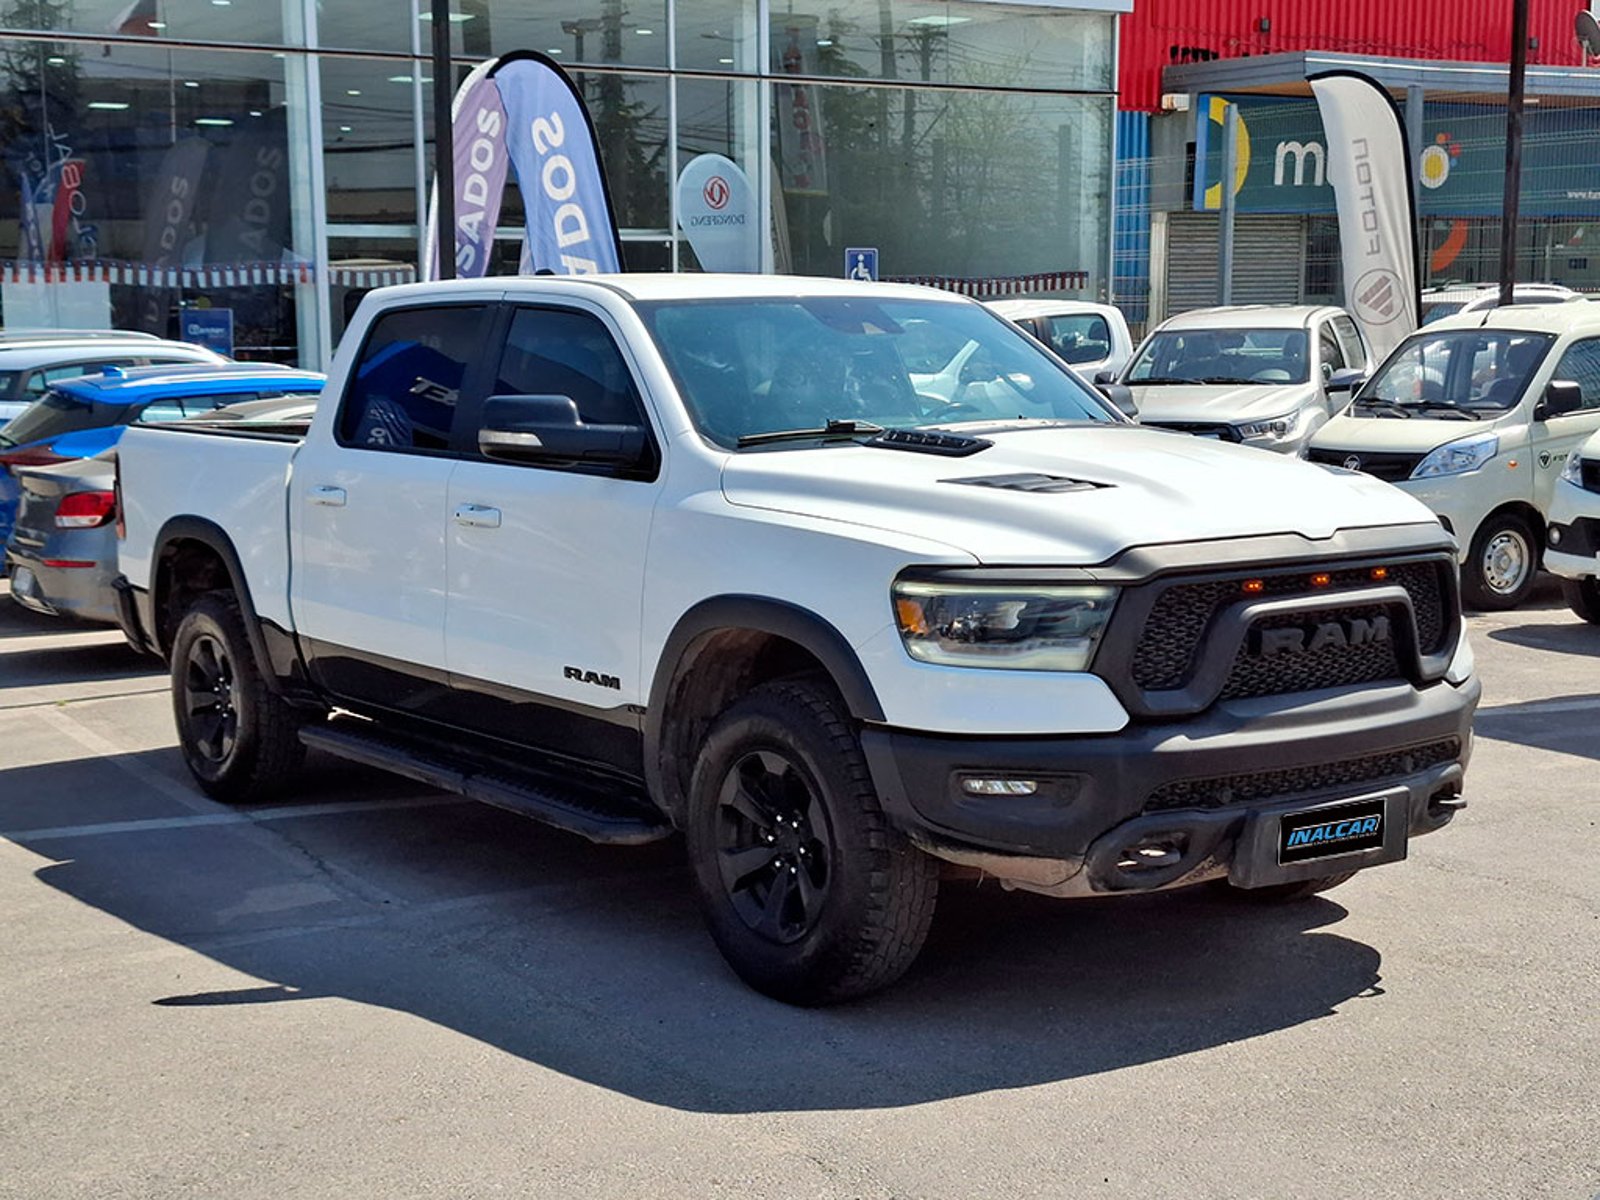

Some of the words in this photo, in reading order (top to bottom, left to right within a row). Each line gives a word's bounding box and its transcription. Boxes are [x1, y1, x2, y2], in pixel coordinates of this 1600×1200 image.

[456, 107, 501, 277] SADOS
[1262, 616, 1388, 653] RAM
[563, 665, 621, 690] RAM
[1287, 819, 1377, 846] INALCAR
